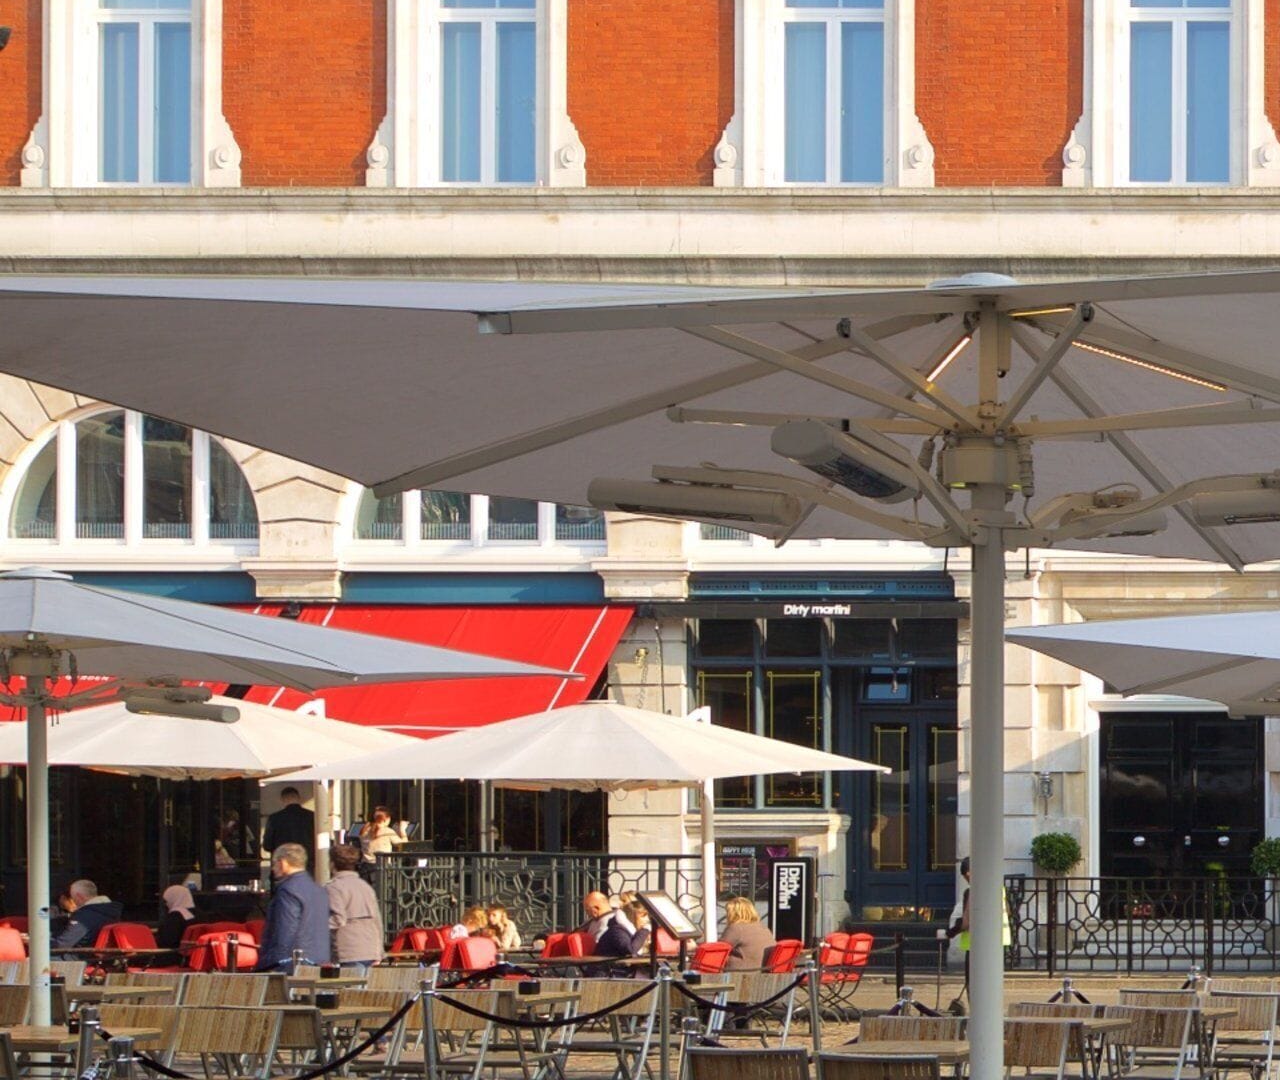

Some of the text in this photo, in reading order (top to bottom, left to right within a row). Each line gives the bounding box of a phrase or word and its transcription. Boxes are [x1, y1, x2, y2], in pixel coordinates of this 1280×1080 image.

[783, 604, 851, 617] Dirty martini
[779, 867, 791, 910] martini
[788, 867, 801, 897] Dirty
